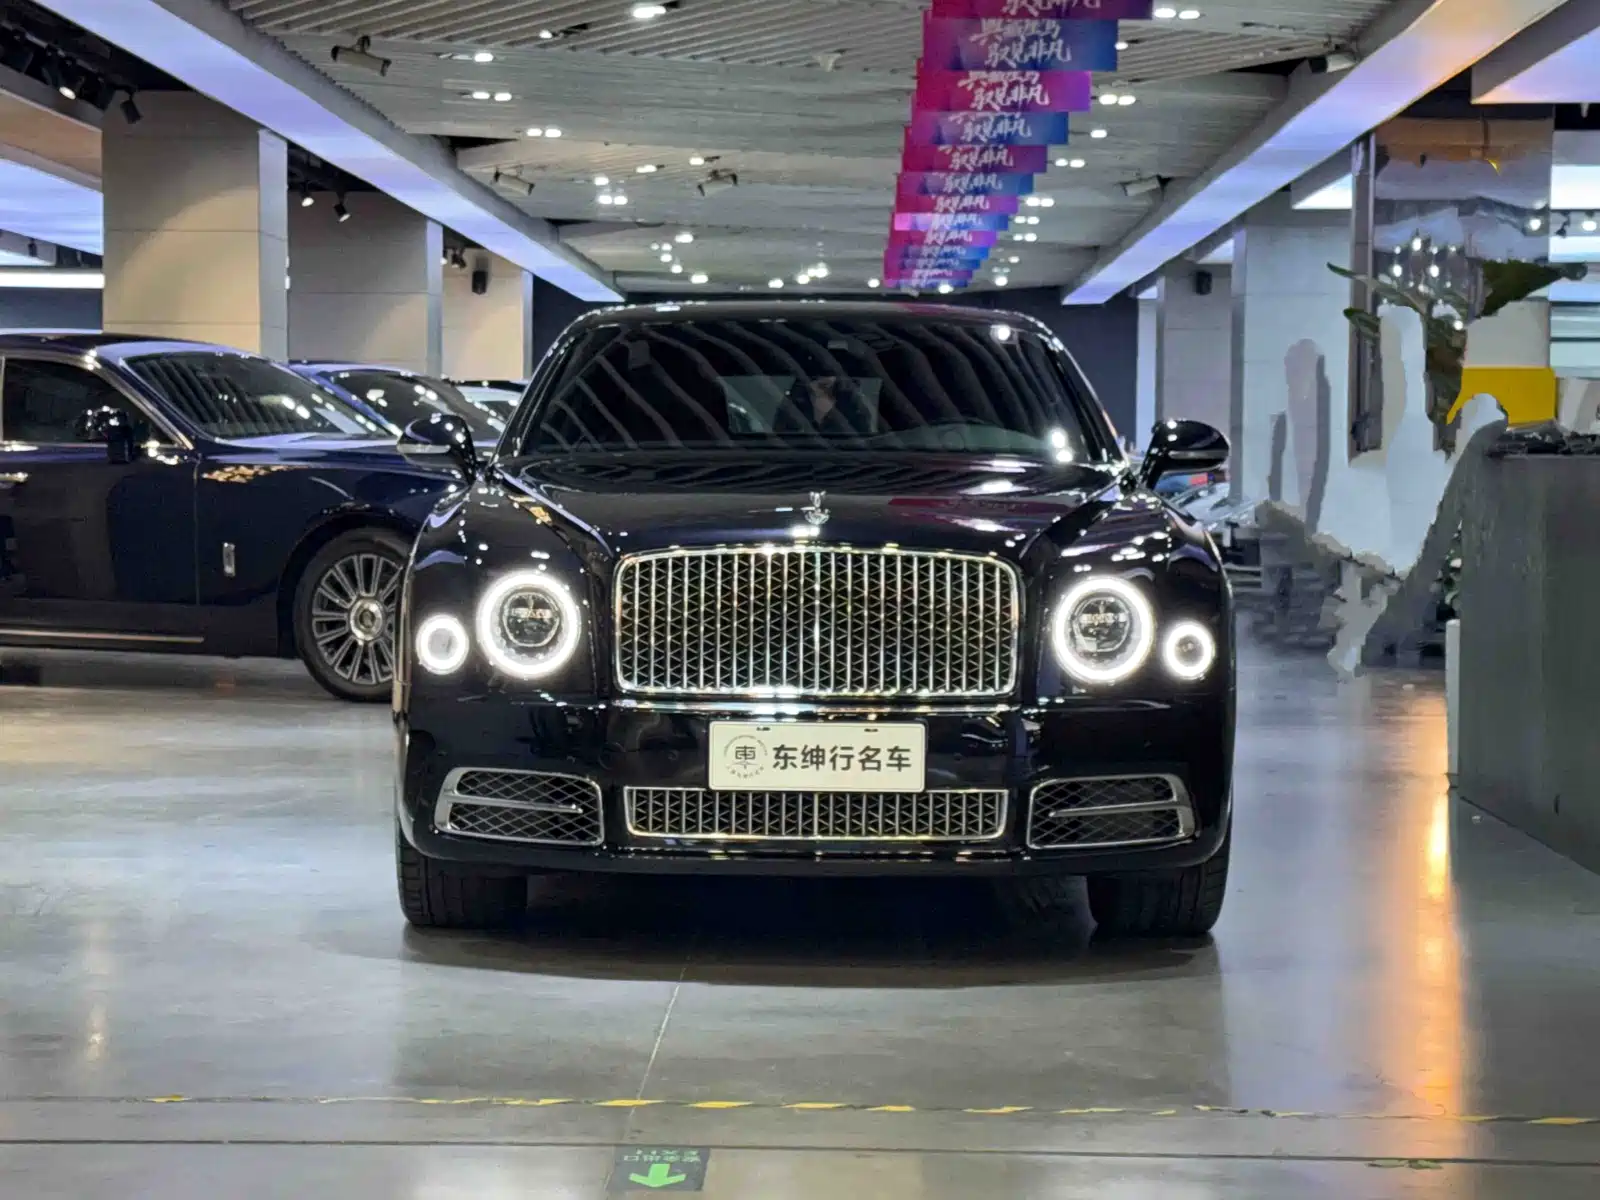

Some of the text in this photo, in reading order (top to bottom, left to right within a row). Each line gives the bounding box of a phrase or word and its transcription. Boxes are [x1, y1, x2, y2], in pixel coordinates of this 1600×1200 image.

[773, 744, 911, 772] 东绅行名车
